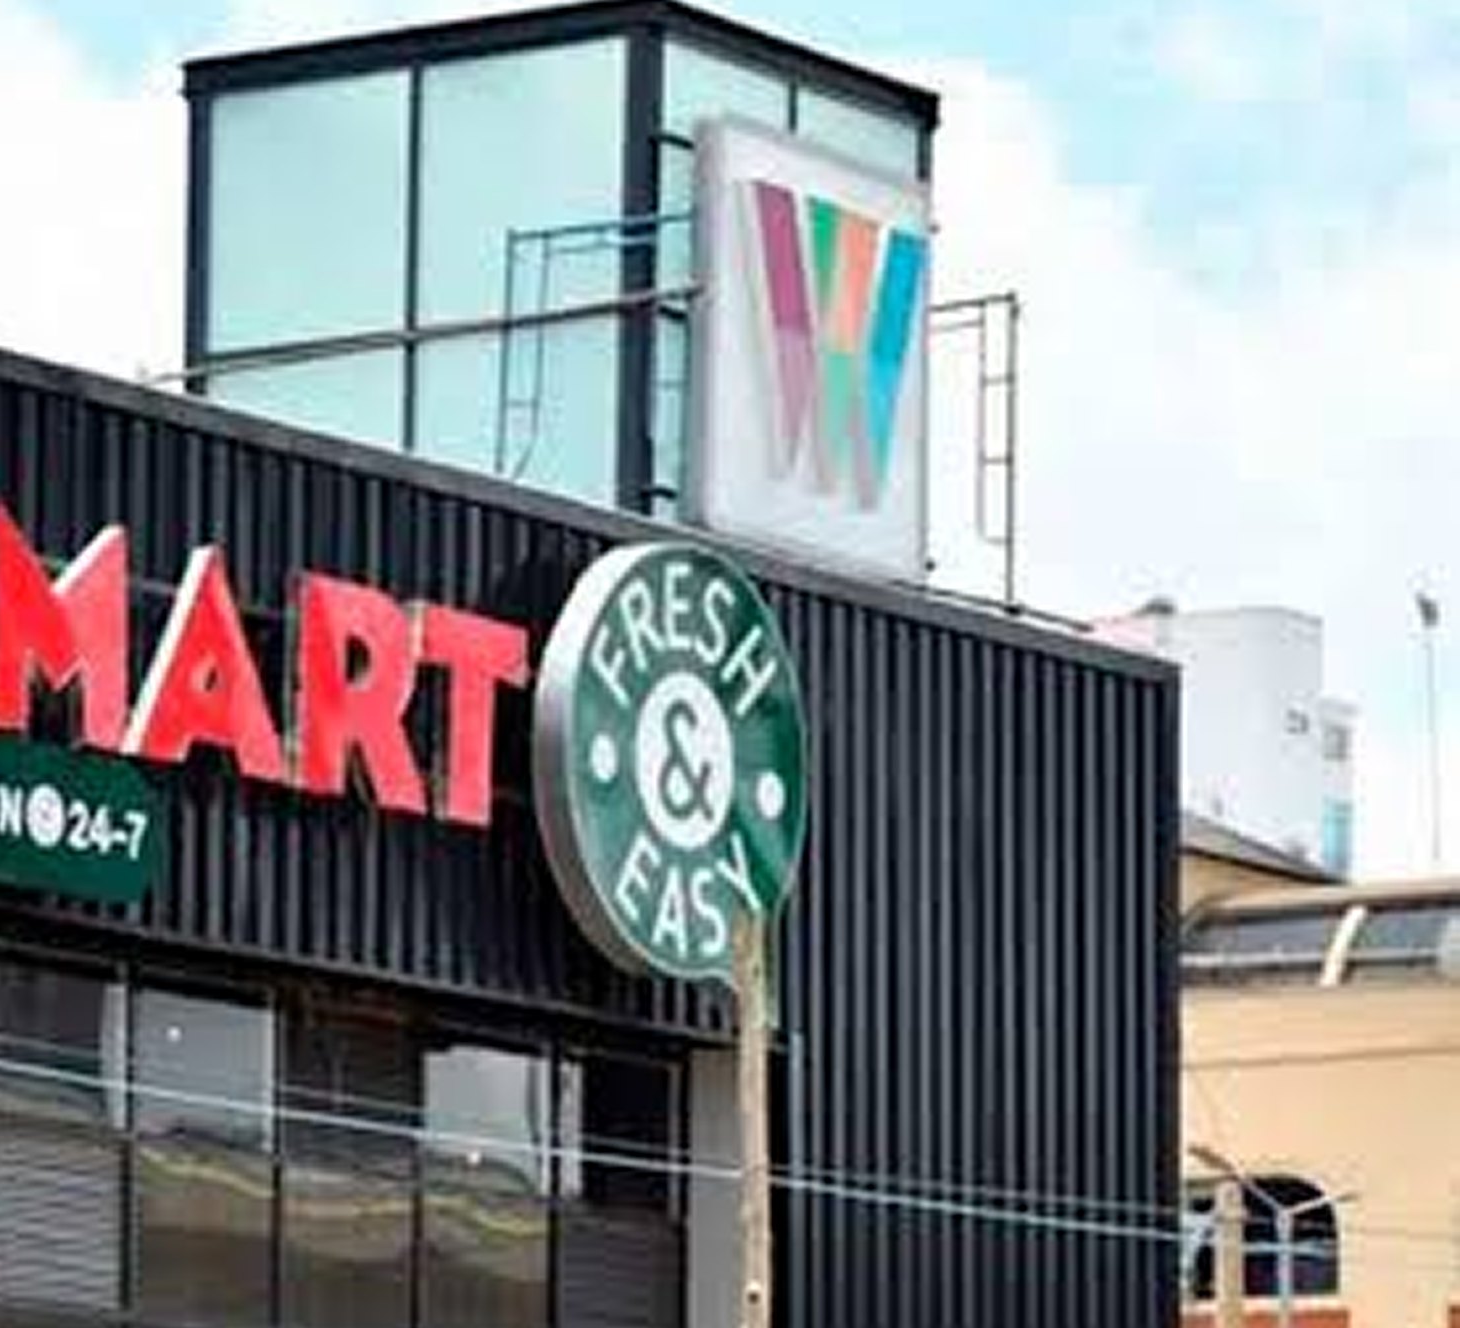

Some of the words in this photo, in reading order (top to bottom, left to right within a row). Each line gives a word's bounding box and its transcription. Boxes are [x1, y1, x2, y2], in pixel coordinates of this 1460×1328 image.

[589, 562, 778, 717] FRESH
[658, 698, 716, 824] &
[66, 800, 149, 860] 24-7
[613, 831, 762, 958] EASY
